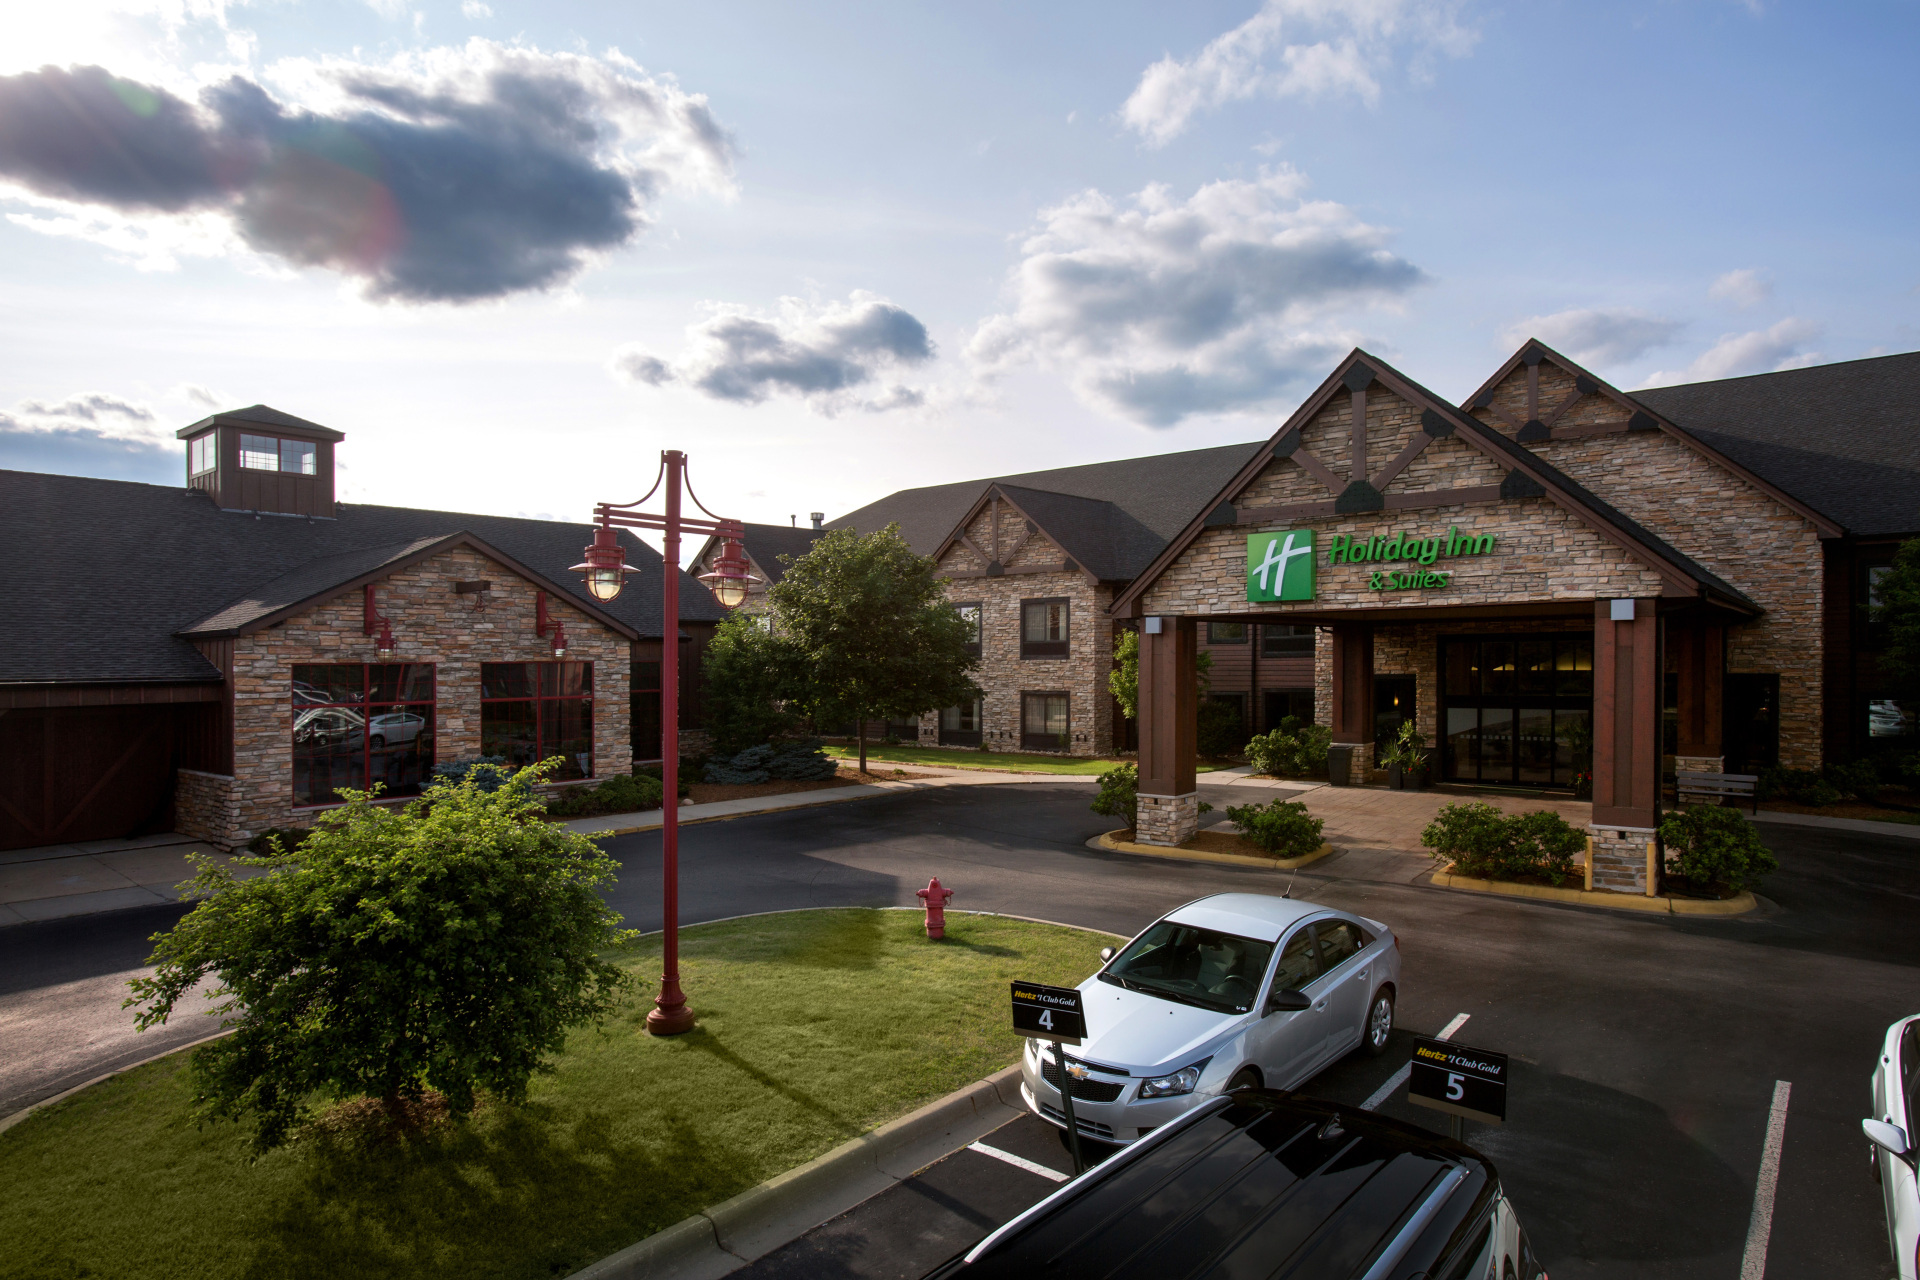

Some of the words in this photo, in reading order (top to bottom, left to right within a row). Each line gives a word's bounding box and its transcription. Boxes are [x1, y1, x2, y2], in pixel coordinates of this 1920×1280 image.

[1328, 531, 1442, 566] Holiday
[1445, 526, 1495, 556] Inn
[1368, 571, 1384, 591] &
[1386, 569, 1450, 590] Suites
[1014, 991, 1036, 1000] Hertz
[1043, 994, 1058, 1004] Club
[1059, 998, 1075, 1006] Gold
[1038, 1009, 1054, 1031] 4
[1417, 1047, 1447, 1061] Hertz
[1455, 1056, 1477, 1069] Club
[1478, 1062, 1501, 1074] Gold
[1445, 1072, 1465, 1101] 5
